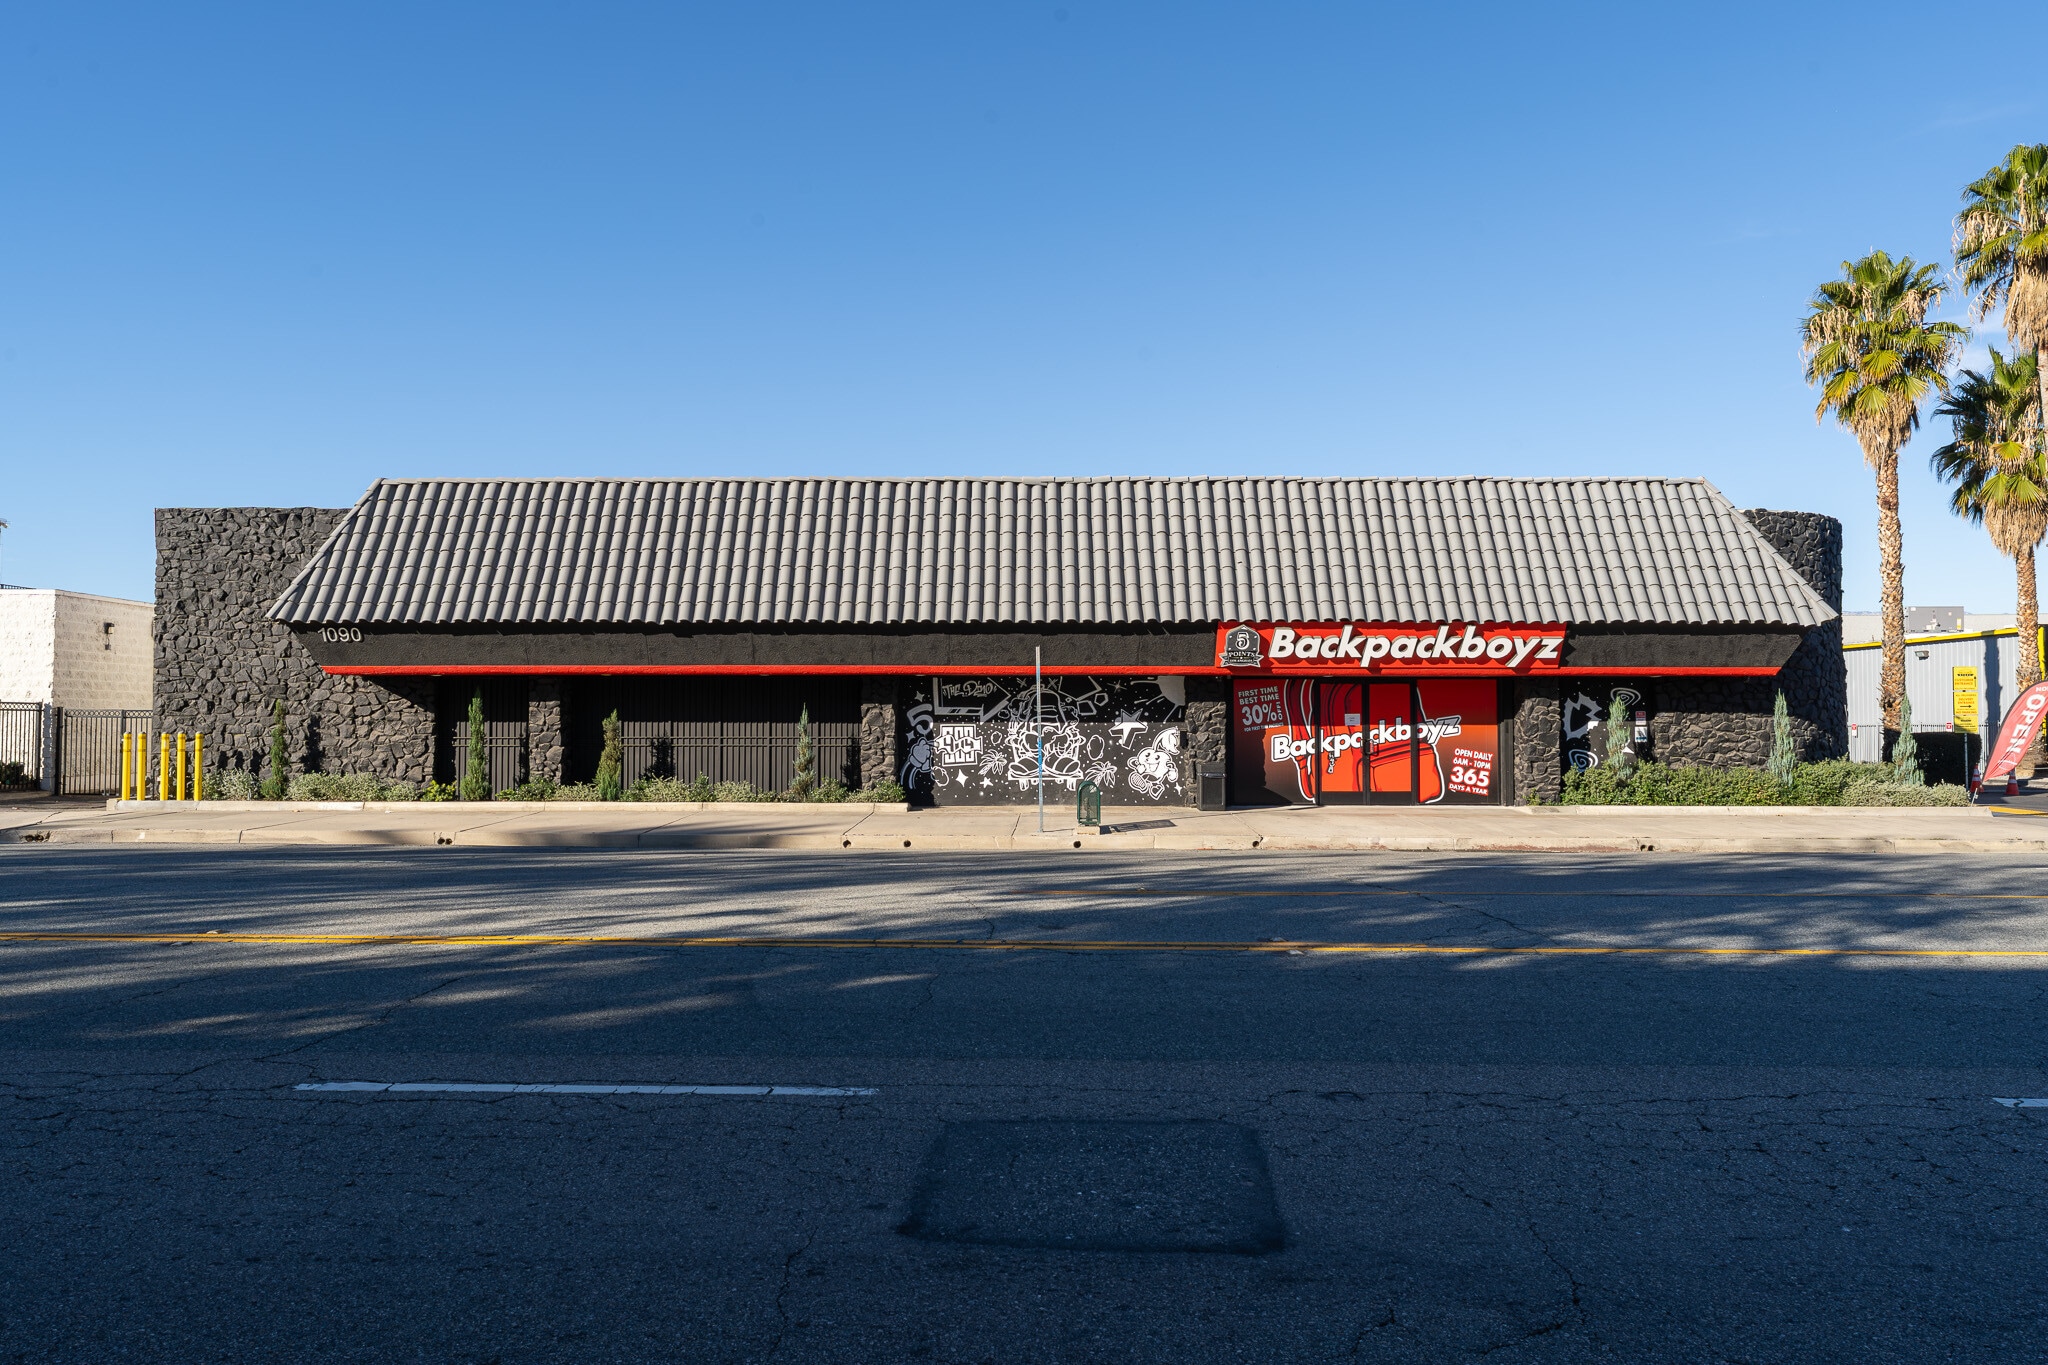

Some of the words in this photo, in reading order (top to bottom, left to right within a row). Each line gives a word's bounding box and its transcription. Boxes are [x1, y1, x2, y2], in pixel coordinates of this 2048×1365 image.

[317, 627, 361, 642] 1090
[1235, 631, 1250, 650] 5
[1228, 650, 1256, 658] POINTS
[1268, 625, 1565, 668] Backpackboyz
[1238, 689, 1258, 697] FIRST
[1260, 686, 1278, 694] TIME
[1239, 696, 1258, 705] BEST
[1260, 693, 1279, 702] TIME
[1241, 702, 1277, 726] 30%
[2006, 693, 2046, 754] OPEN
[1272, 715, 1461, 762] Backpackboyz
[1454, 748, 1473, 758] OPEN
[1473, 751, 1493, 761] DAILY
[1453, 757, 1469, 766] 6AM
[1474, 760, 1491, 769] 10PM
[1450, 766, 1490, 787] 365
[1449, 783, 1465, 791] DAYS
[1472, 787, 1488, 795] YEAR
